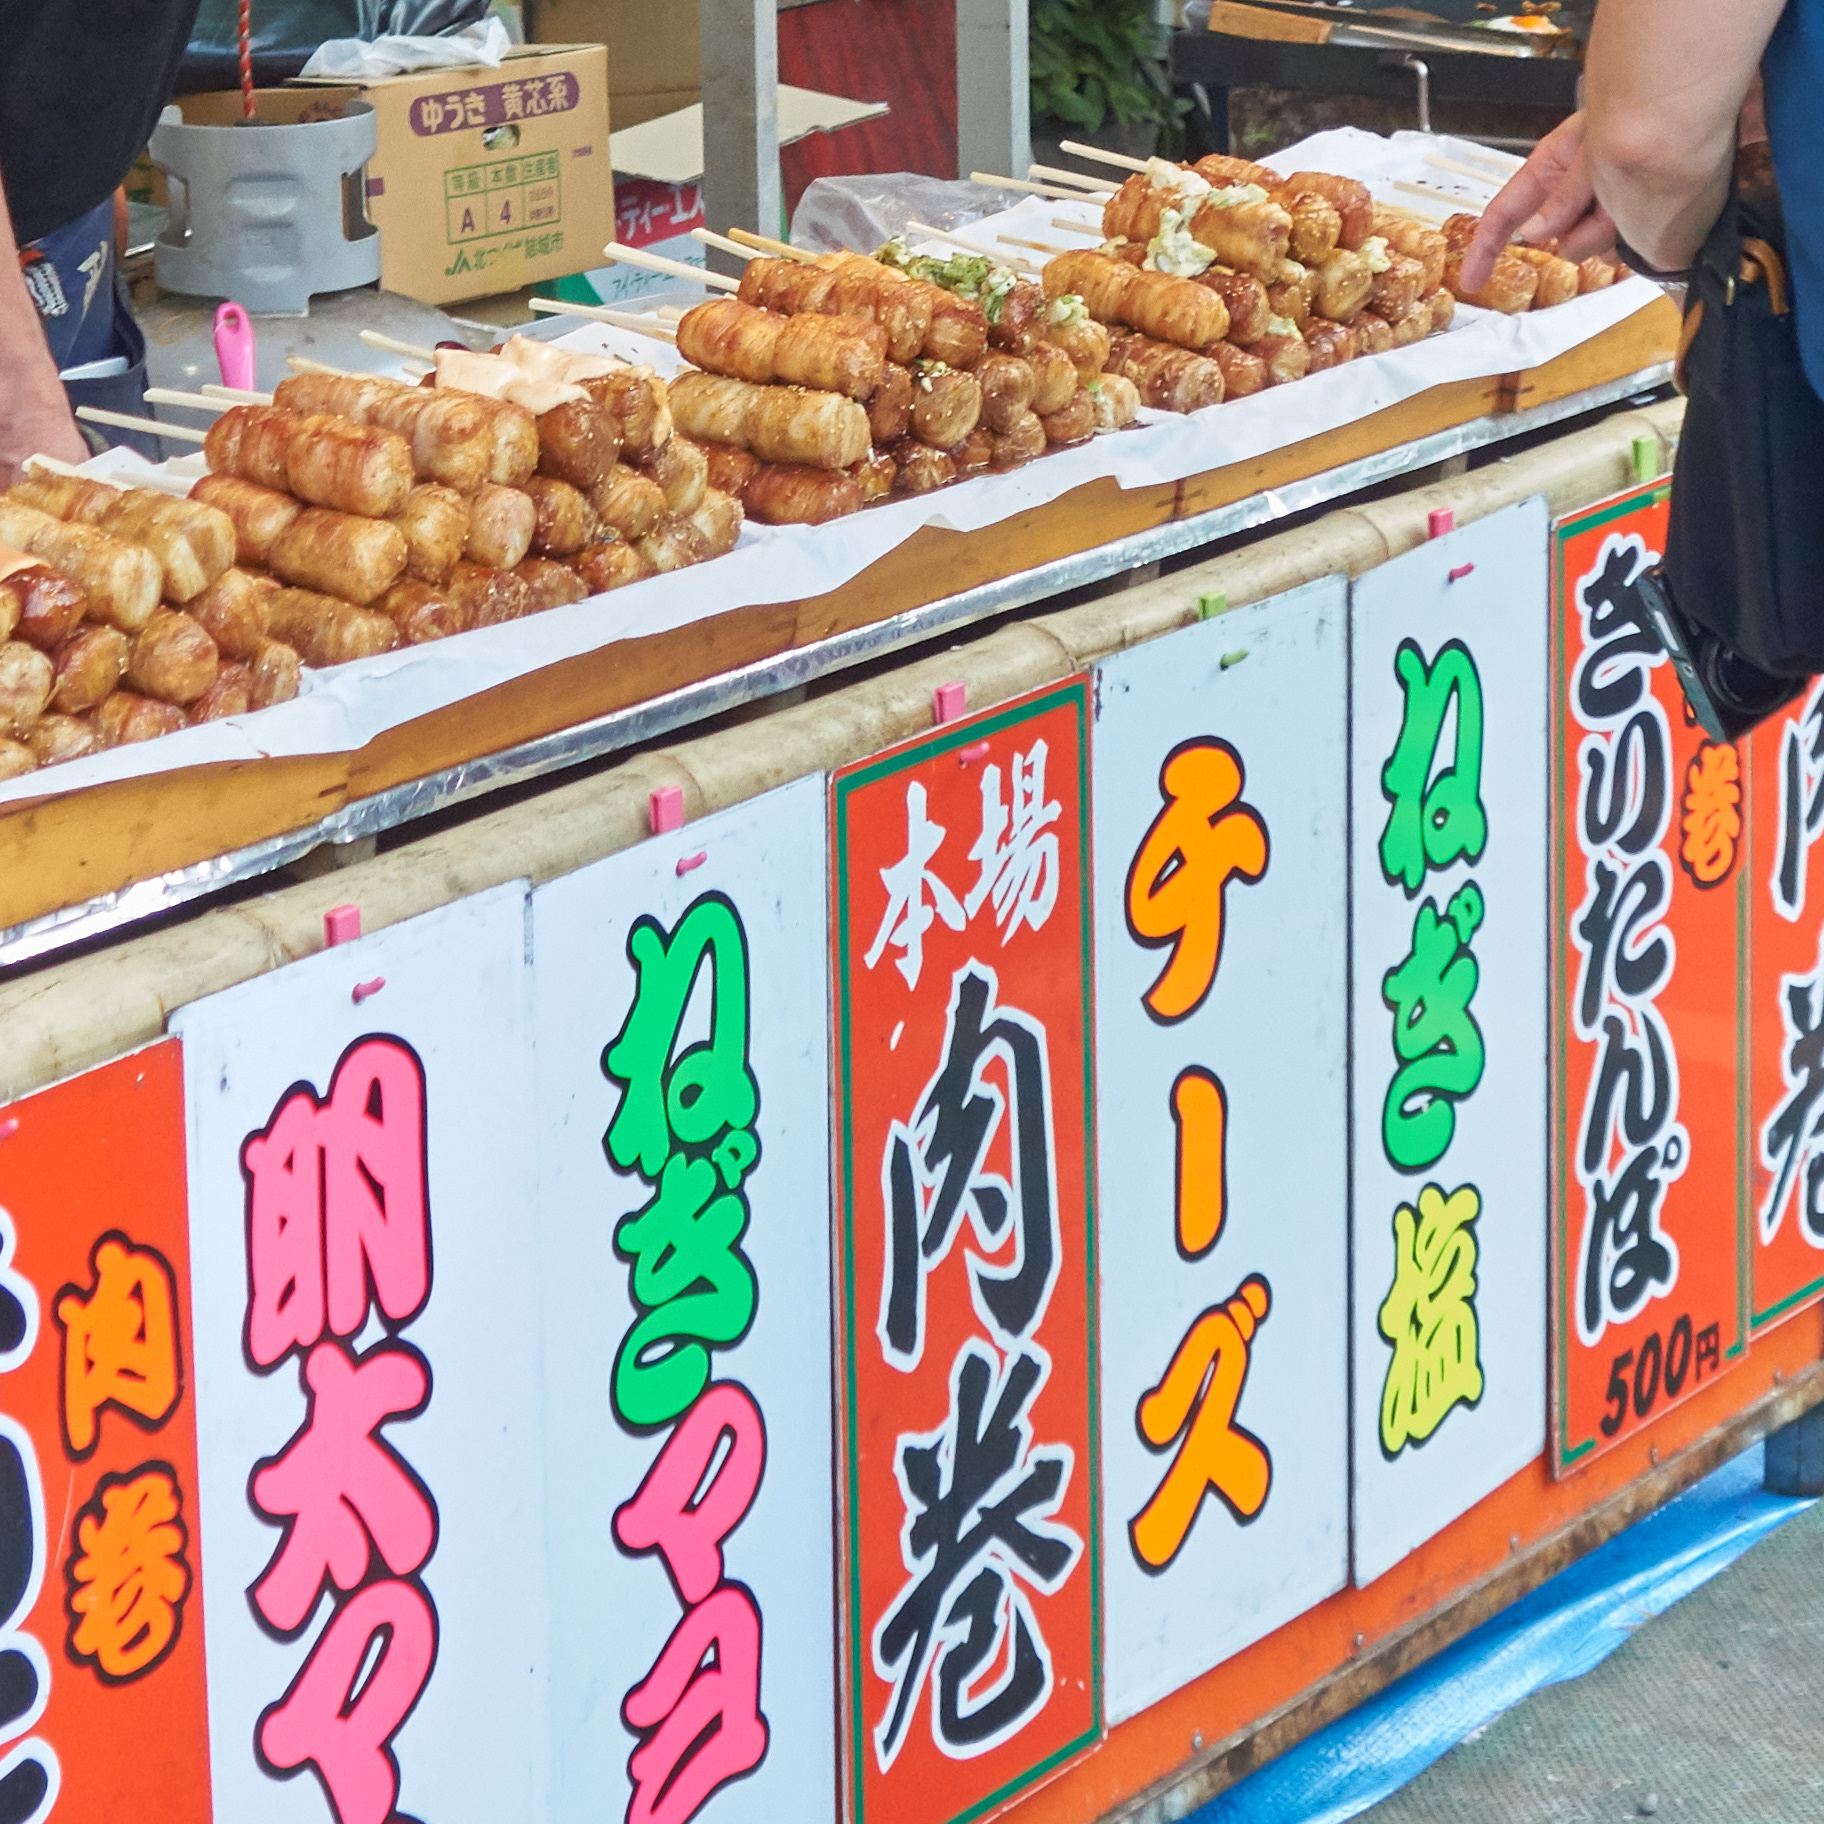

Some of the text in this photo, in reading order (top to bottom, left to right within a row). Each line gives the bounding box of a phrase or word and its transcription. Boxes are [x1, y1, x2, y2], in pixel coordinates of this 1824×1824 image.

[421, 93, 487, 134] ゆうき
[460, 208, 475, 233] A
[499, 200, 512, 224] 4
[865, 738, 1063, 990] 本場
[1376, 635, 1489, 1461] ねぎ塩
[1572, 531, 1690, 1346] きりたんぽ
[872, 956, 1084, 1774] 肉巻
[1126, 734, 1273, 1575] チーズ
[1599, 1312, 1720, 1438] 500円
[53, 1227, 190, 1686] 肉巻
